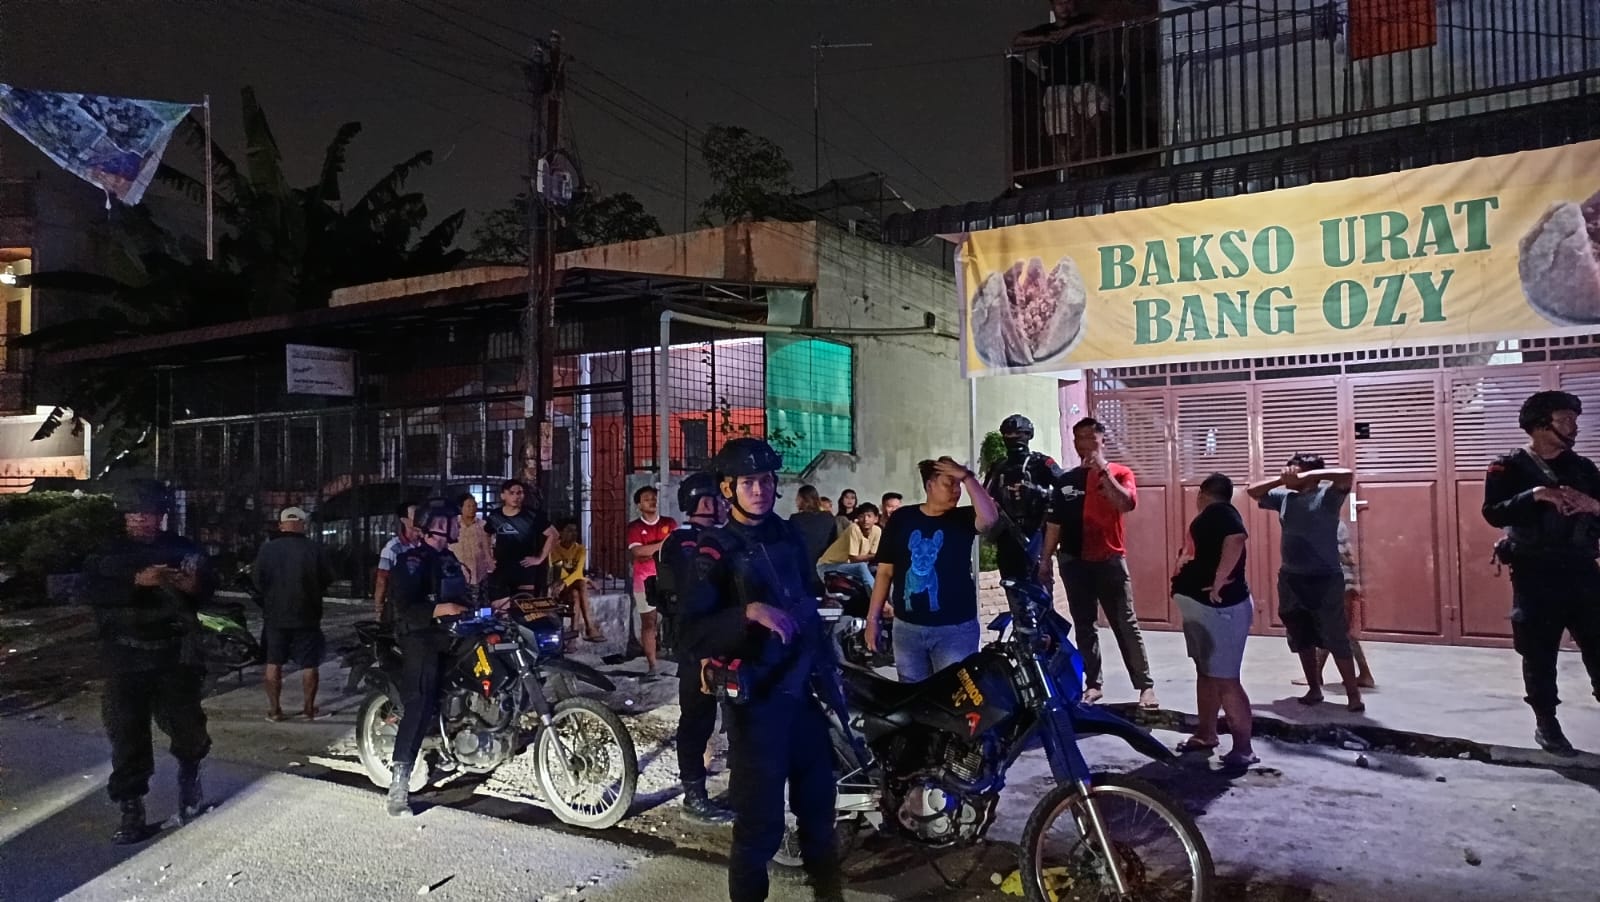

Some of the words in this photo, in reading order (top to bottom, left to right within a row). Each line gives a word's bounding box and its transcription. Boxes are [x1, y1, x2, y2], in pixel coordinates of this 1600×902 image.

[1098, 225, 1295, 291] BAKSO
[1320, 196, 1500, 269] URAT
[1133, 286, 1297, 345] BANG
[1323, 269, 1454, 330] OZY
